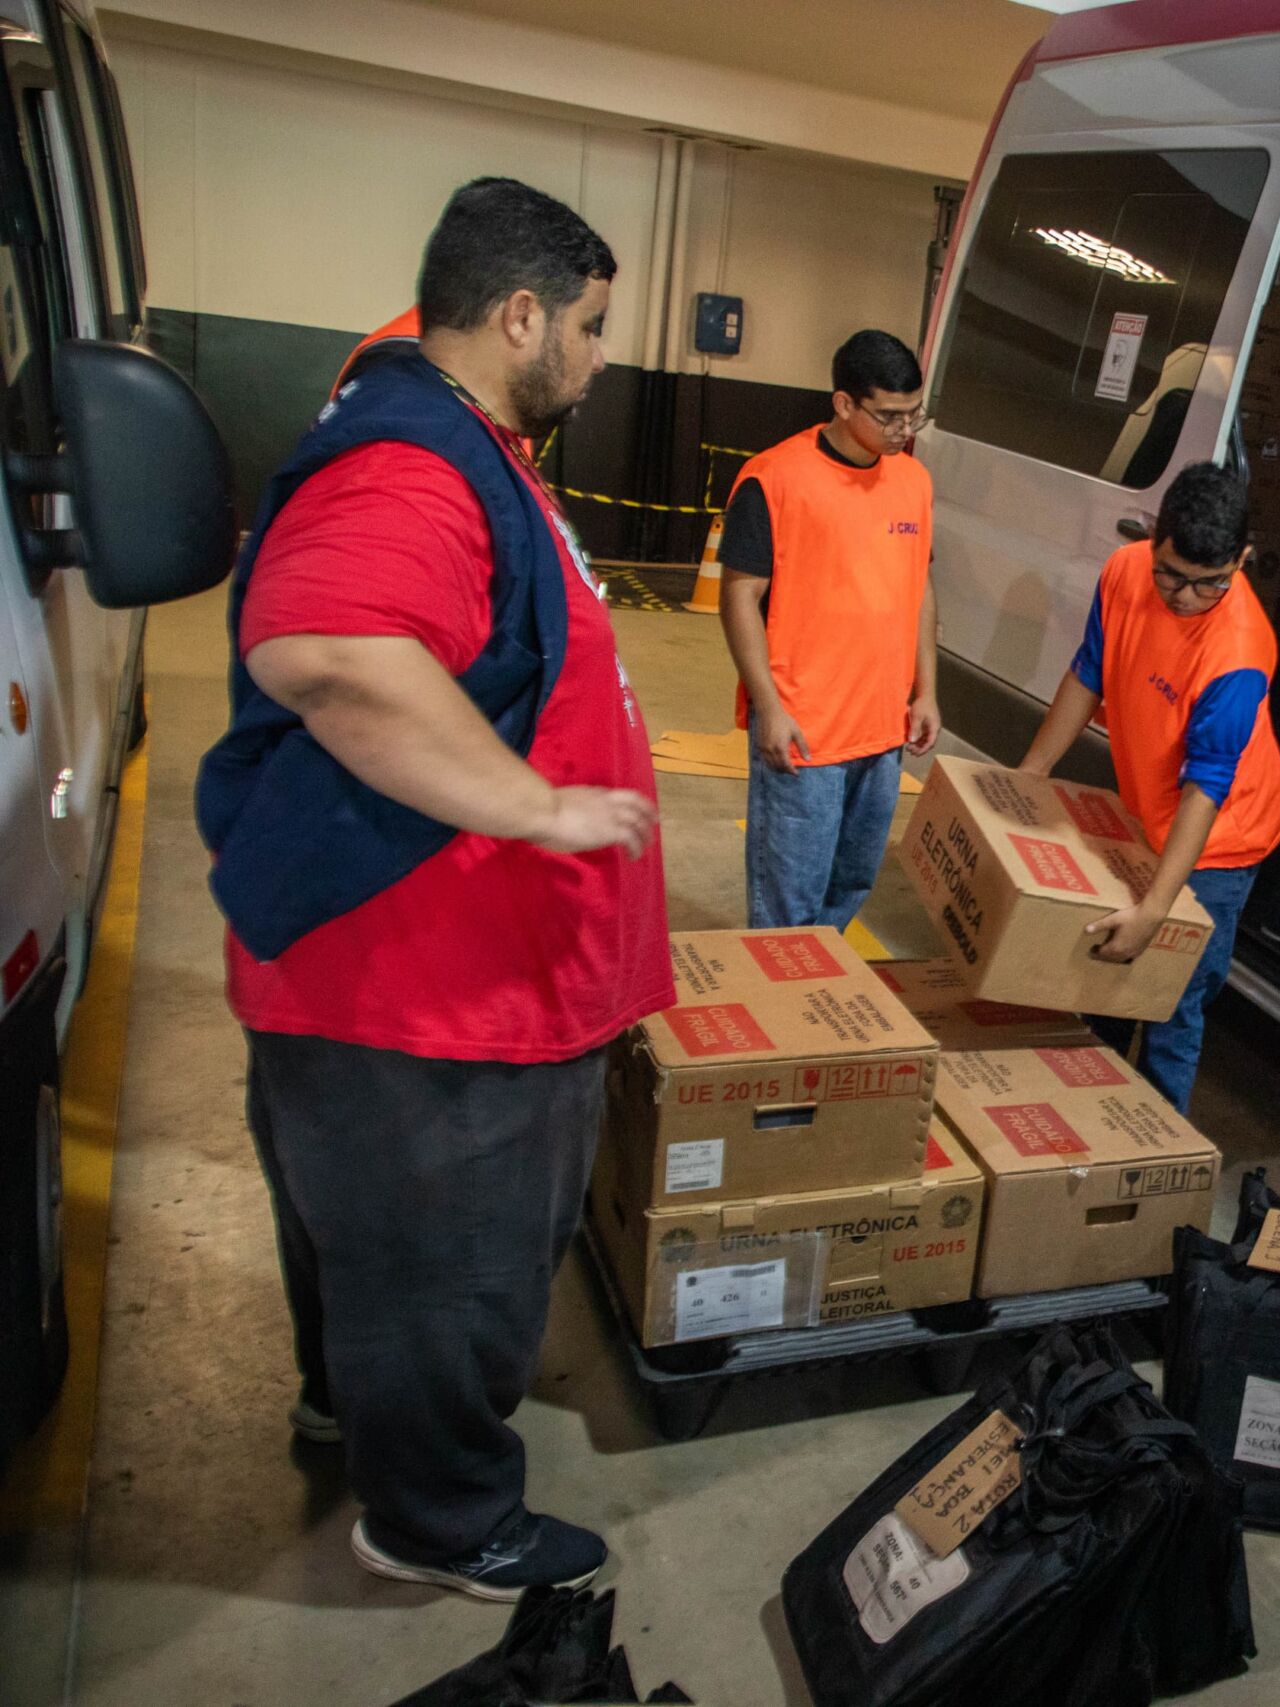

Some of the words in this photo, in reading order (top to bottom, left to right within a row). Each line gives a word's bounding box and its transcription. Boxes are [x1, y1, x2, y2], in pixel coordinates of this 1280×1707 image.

[947, 816, 978, 878] URNA
[920, 820, 984, 936] ELETRÔNICA
[761, 937, 803, 978] CUIDADO
[707, 1008, 751, 1051] CUIDADO
[677, 1083, 713, 1105] UE
[723, 1079, 780, 1101] 2015
[833, 1067, 855, 1086] 12
[1021, 1105, 1076, 1154] CUIDADO
[893, 1246, 919, 1263] UE
[924, 1239, 966, 1258] 2015
[817, 1300, 895, 1320] LEITORAL
[820, 1285, 886, 1304] JUSTIÇA
[918, 1421, 1010, 1508] ESPERANÇA
[970, 1474, 1019, 1516] ROTA
[952, 1515, 971, 1533] 2
[907, 1576, 922, 1591] 40
